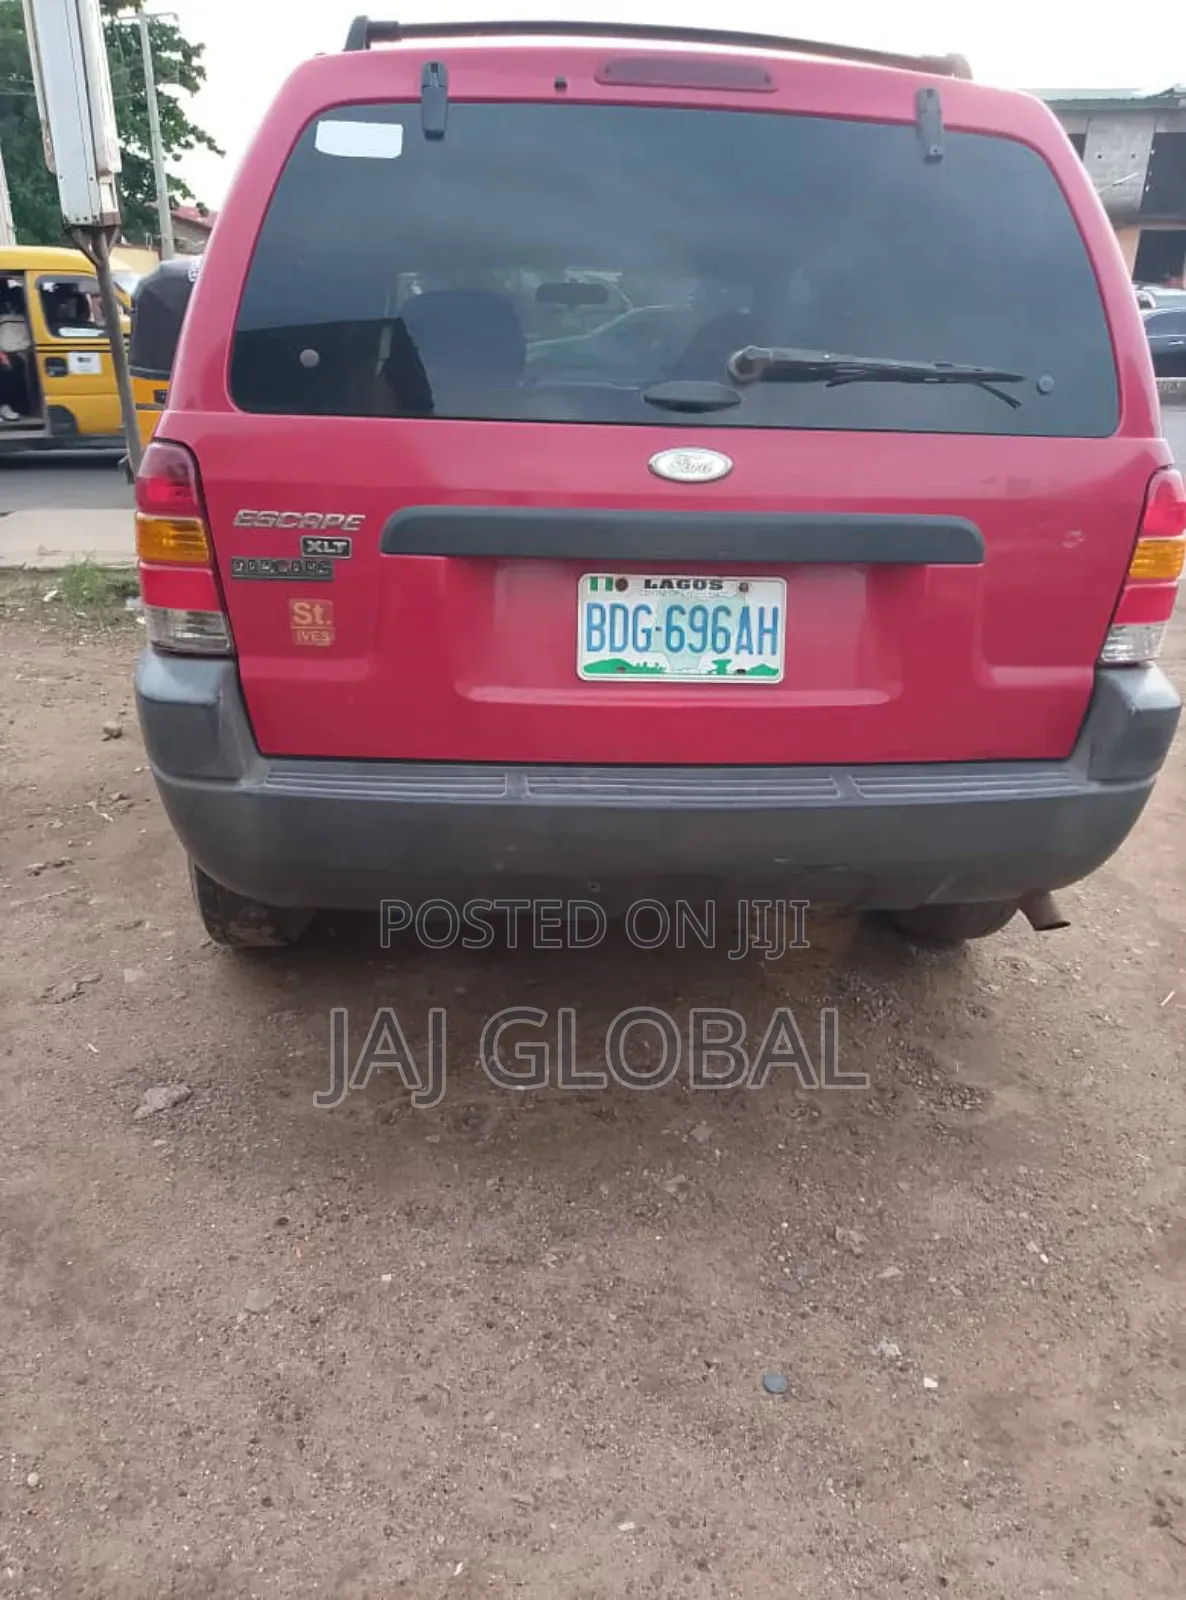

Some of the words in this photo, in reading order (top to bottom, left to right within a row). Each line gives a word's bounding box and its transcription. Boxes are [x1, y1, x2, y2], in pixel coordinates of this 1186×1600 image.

[233, 509, 366, 531] ESCAPE
[306, 540, 347, 553] XLT
[643, 578, 724, 591] LAGOS
[292, 602, 331, 625] St.
[296, 631, 330, 641] IVES
[586, 602, 780, 656] BDG-696AH
